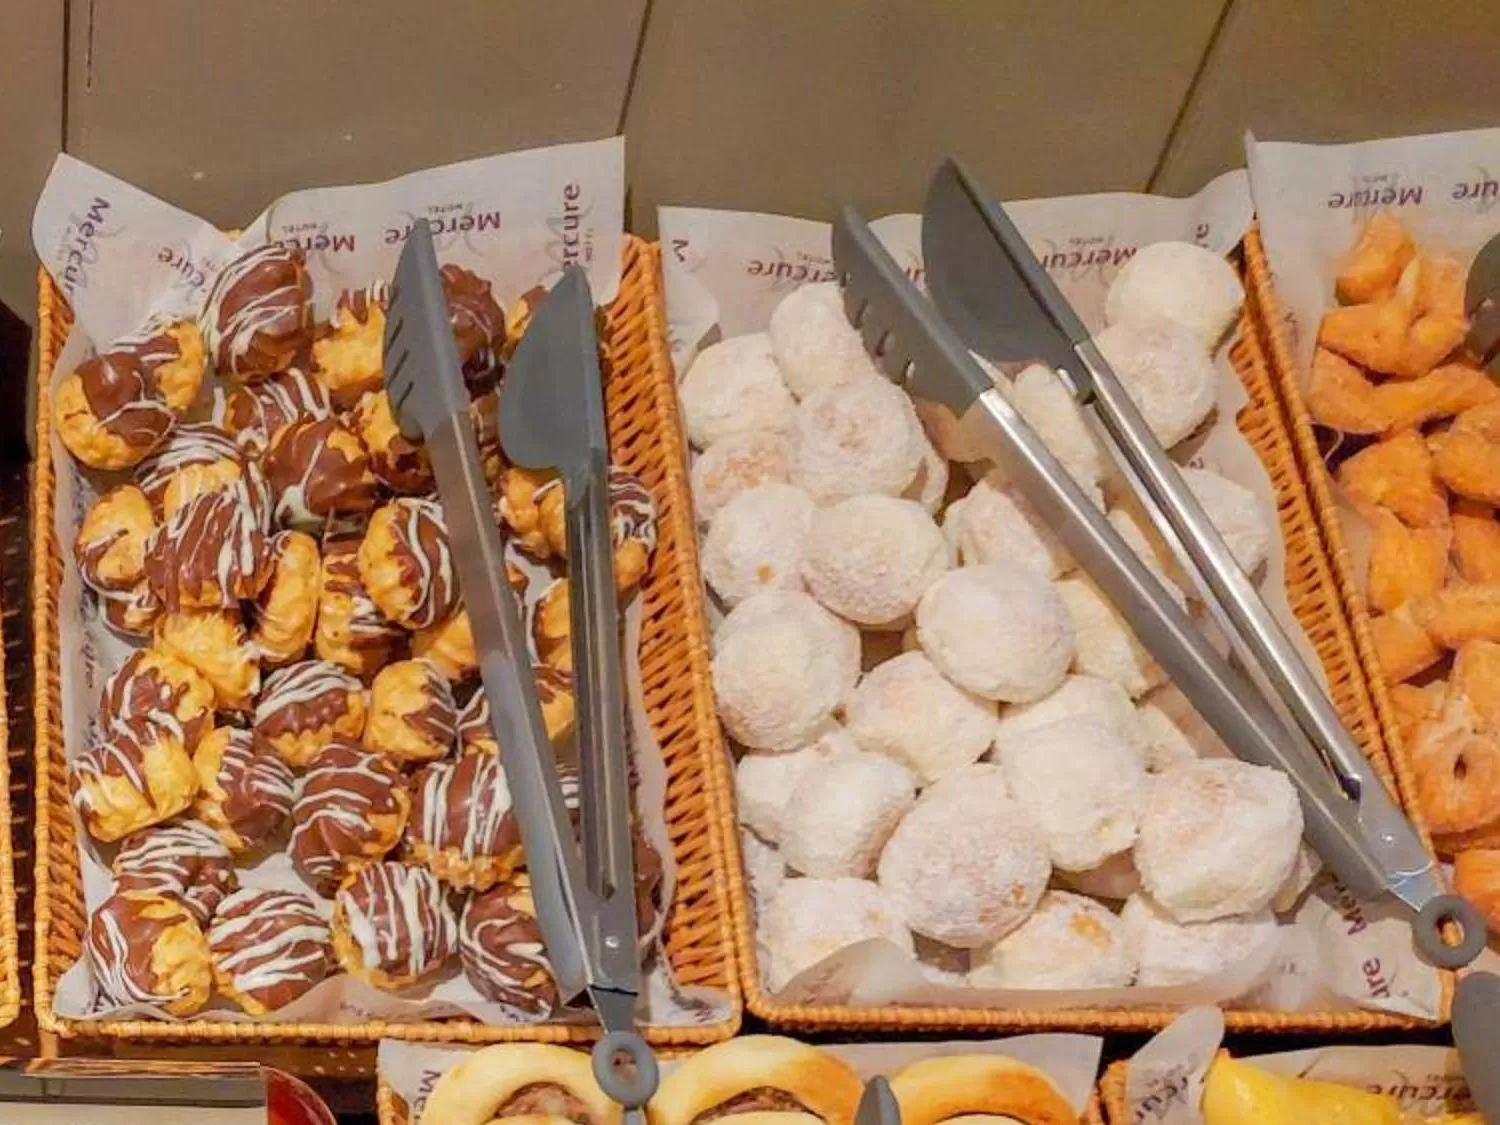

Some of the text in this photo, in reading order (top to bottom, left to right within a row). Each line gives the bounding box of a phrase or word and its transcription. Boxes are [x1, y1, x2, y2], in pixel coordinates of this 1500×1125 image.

[385, 210, 501, 245] Mercre
[563, 183, 581, 271] ercure
[64, 196, 110, 297] Mercur
[1043, 247, 1137, 270] Mercur
[746, 259, 838, 284] ercure
